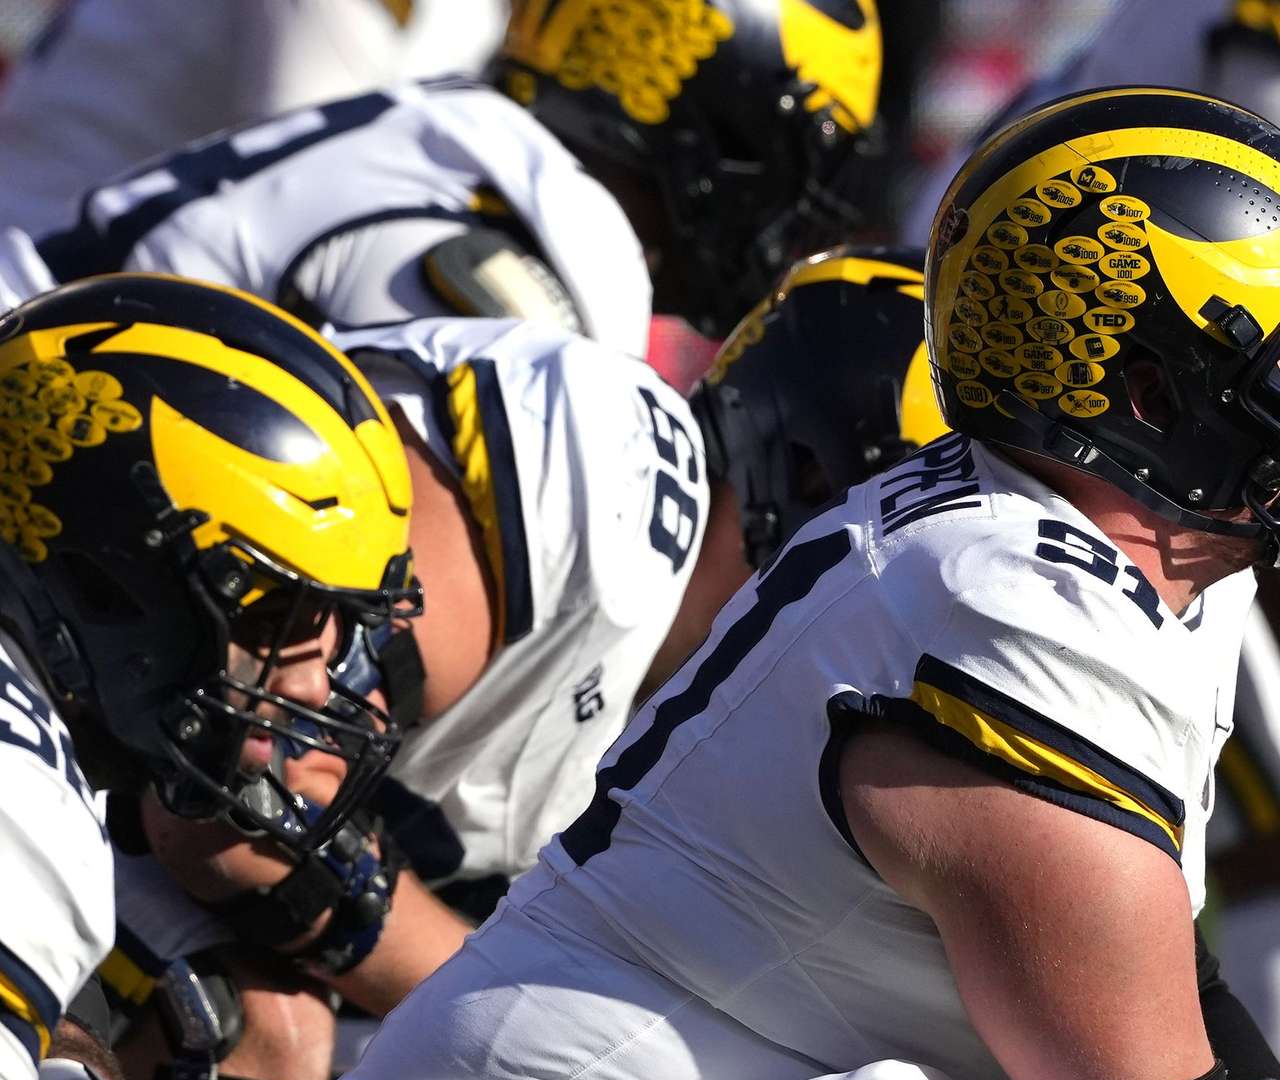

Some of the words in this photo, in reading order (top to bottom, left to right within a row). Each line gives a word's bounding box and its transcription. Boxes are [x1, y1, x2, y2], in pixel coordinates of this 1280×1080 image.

[1124, 206, 1144, 218] 1007
[1122, 236, 1141, 248] 1006
[1079, 250, 1098, 260] 1000
[1109, 259, 1141, 270] GAME
[1116, 270, 1133, 280] 1001
[1091, 313, 1127, 328] TED
[1035, 518, 1165, 631] 51
